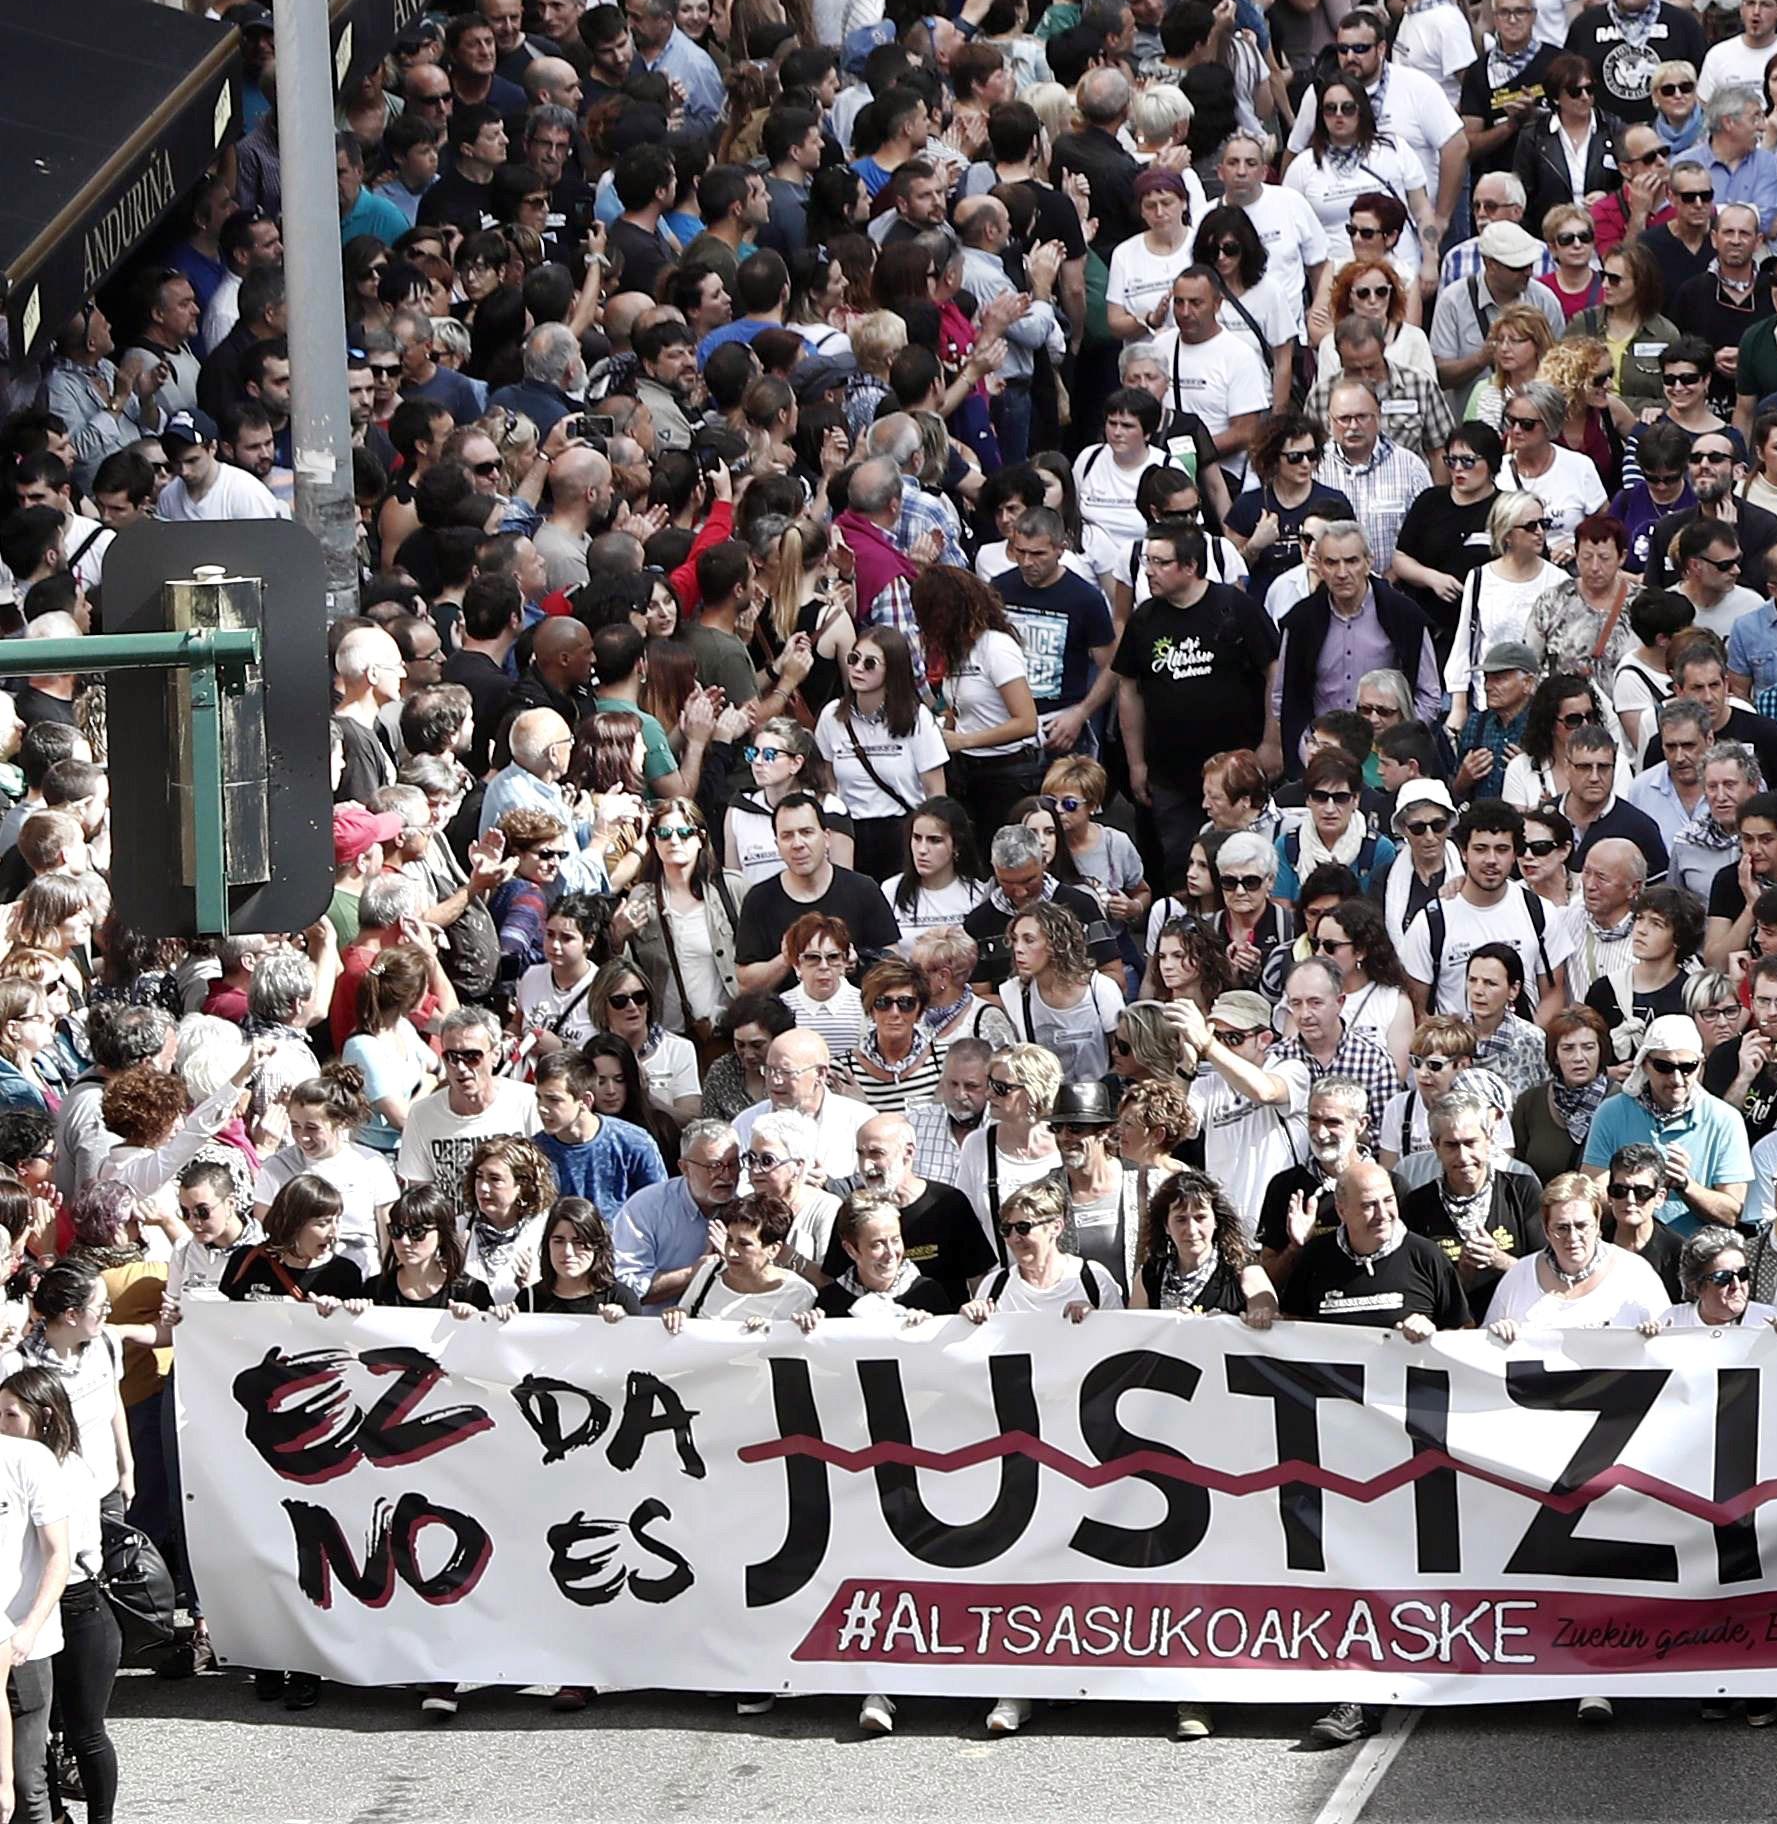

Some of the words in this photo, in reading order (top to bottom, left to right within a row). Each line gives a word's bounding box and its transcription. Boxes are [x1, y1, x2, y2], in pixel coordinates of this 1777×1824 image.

[82, 148, 176, 295] ANDURIÑA
[232, 1345, 496, 1485] EZ
[511, 1371, 706, 1480] DA
[282, 1492, 494, 1610] NO
[546, 1497, 696, 1608] ES
[1551, 1616, 1648, 1650] Zuekin
[1655, 1622, 1755, 1661] gaude,
